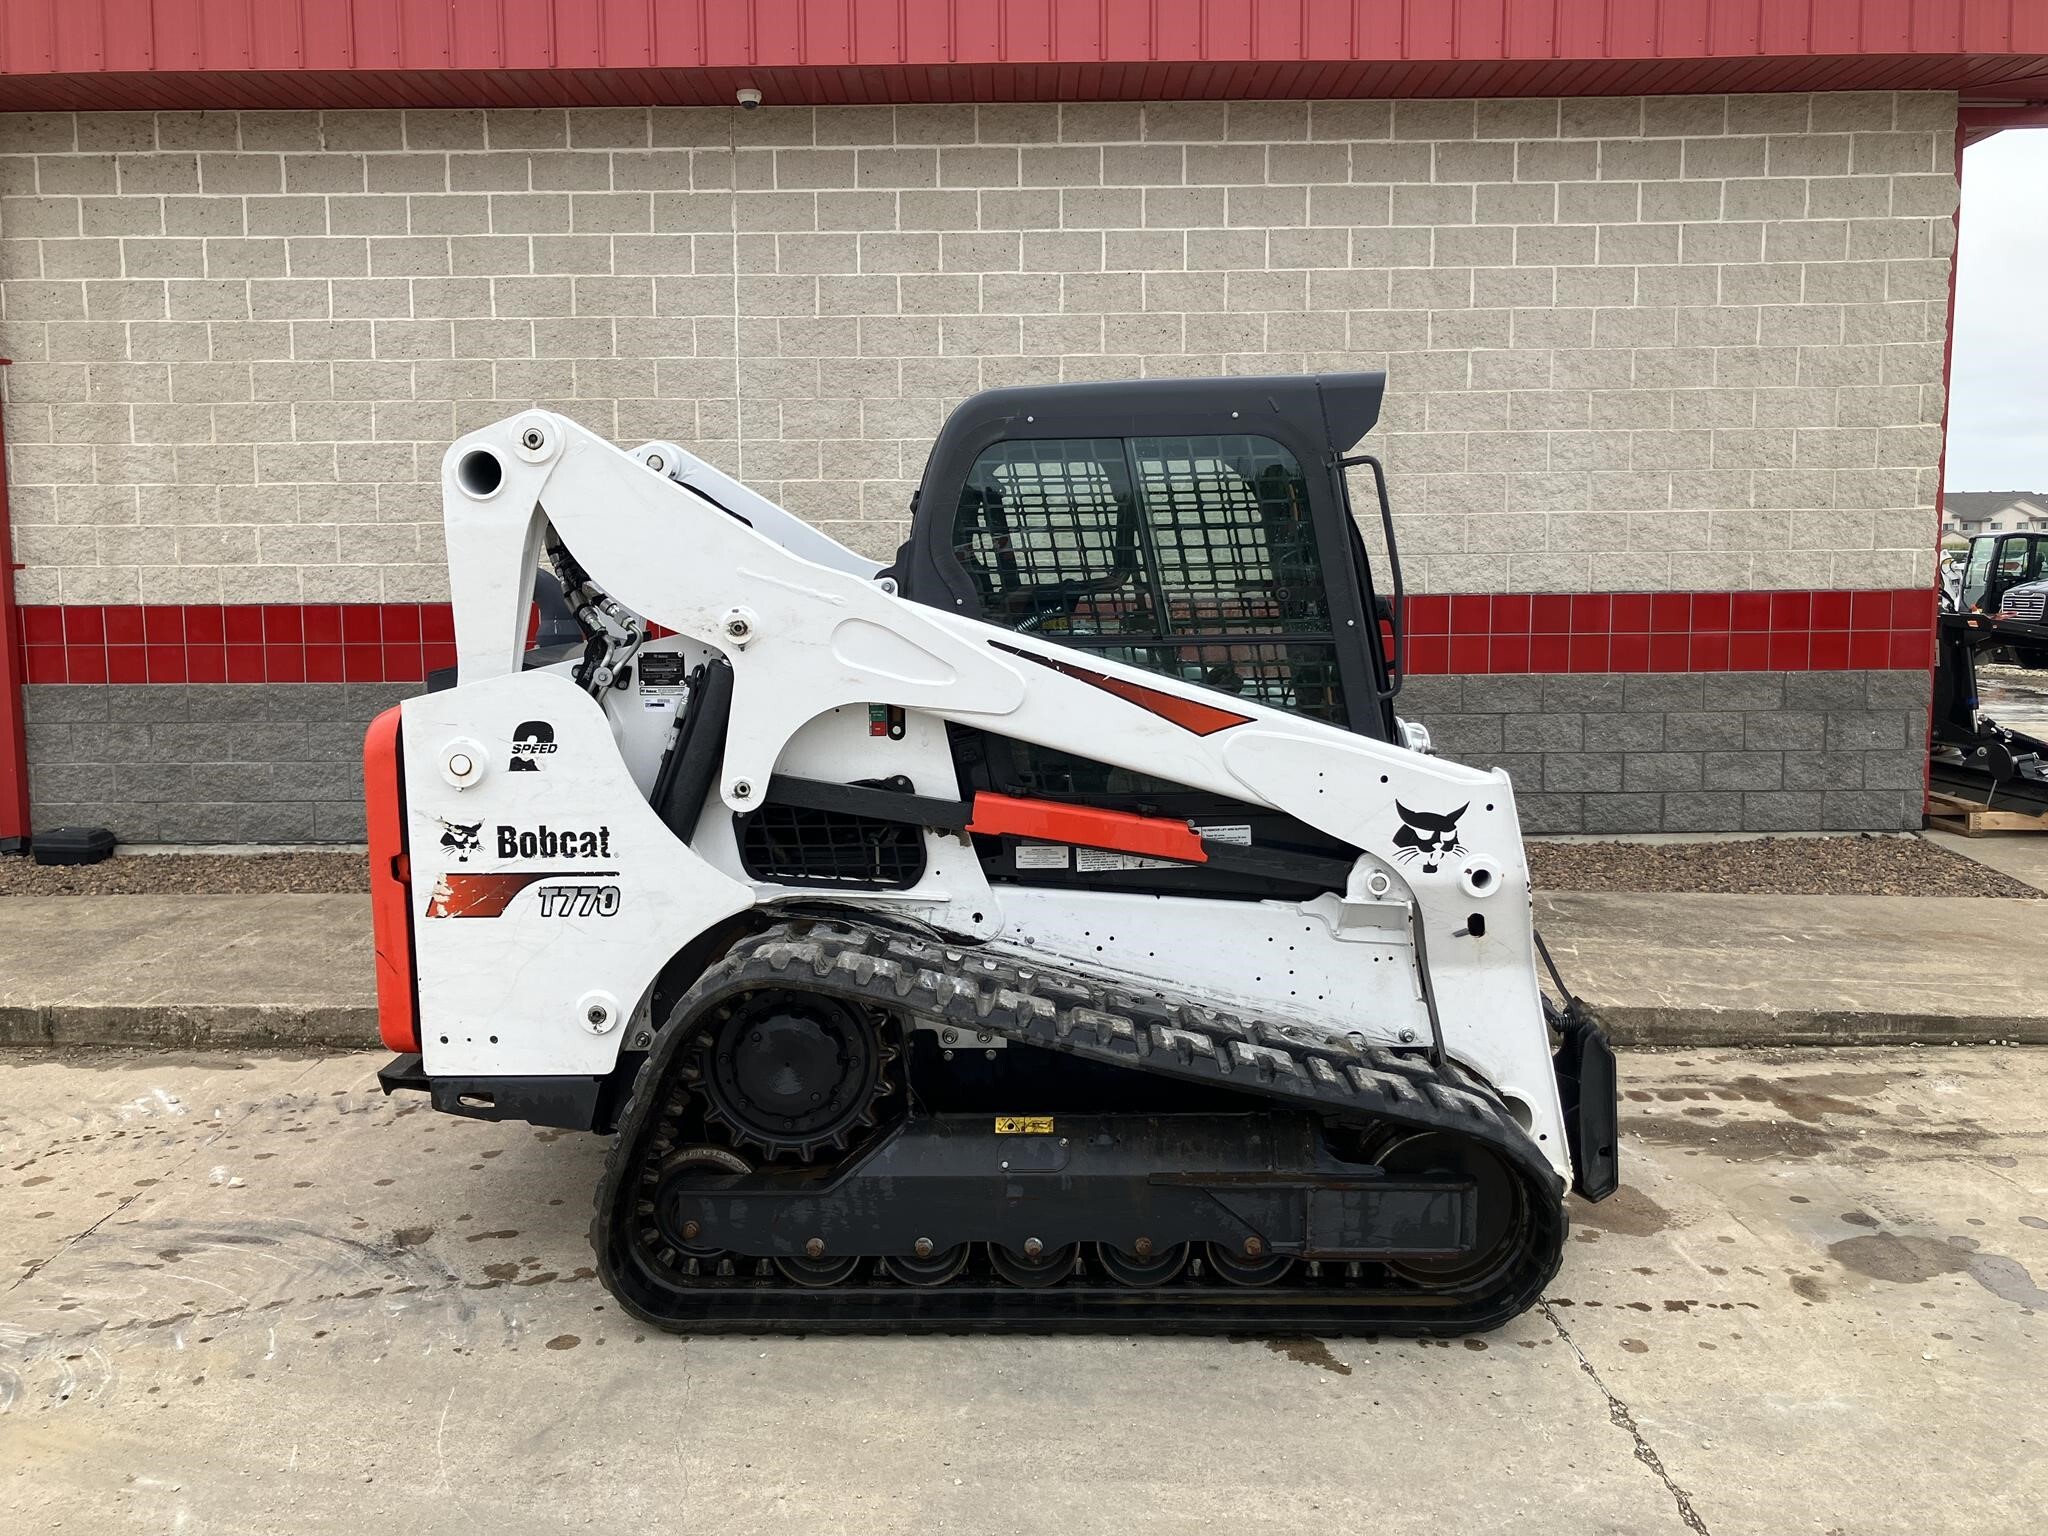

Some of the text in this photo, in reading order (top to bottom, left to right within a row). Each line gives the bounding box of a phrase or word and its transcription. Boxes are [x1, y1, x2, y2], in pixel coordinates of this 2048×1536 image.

[511, 743, 558, 754] SPEED
[496, 825, 611, 858] Bobcat
[538, 885, 621, 917] T770
